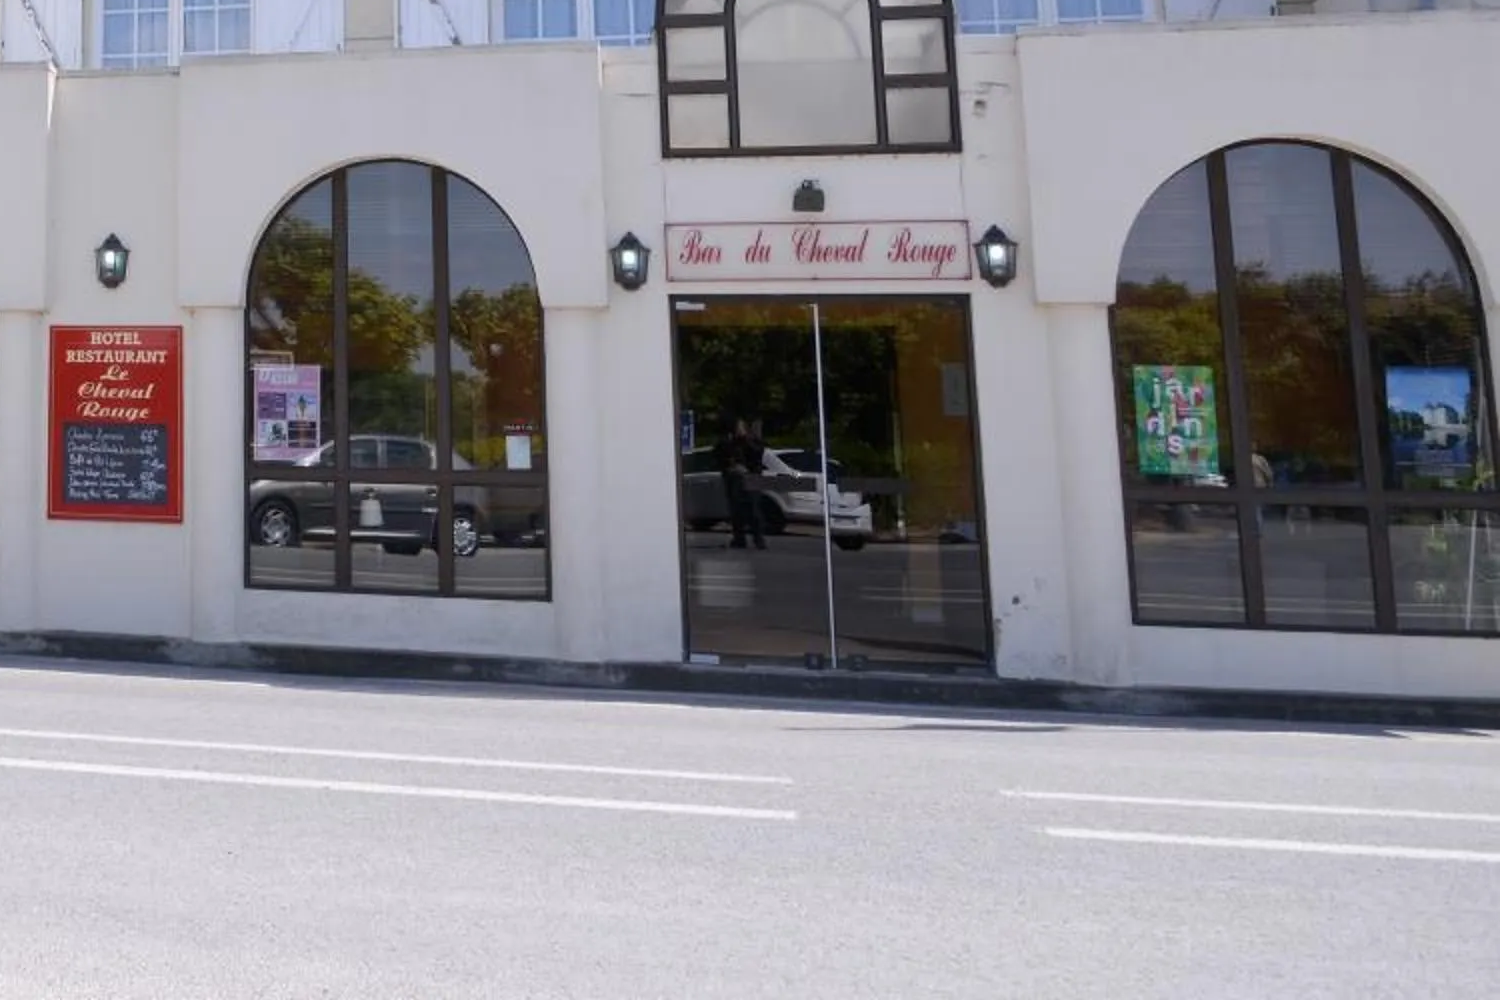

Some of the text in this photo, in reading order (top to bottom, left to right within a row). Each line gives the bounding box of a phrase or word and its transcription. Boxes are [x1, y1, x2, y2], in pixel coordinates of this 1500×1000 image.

[679, 227, 957, 278] Bar du Cheval Rouge
[90, 331, 143, 345] HOTEL
[66, 350, 167, 363] RESTAURANT
[100, 365, 130, 381] Le
[77, 382, 155, 400] Cheval
[76, 401, 150, 422] Rouge
